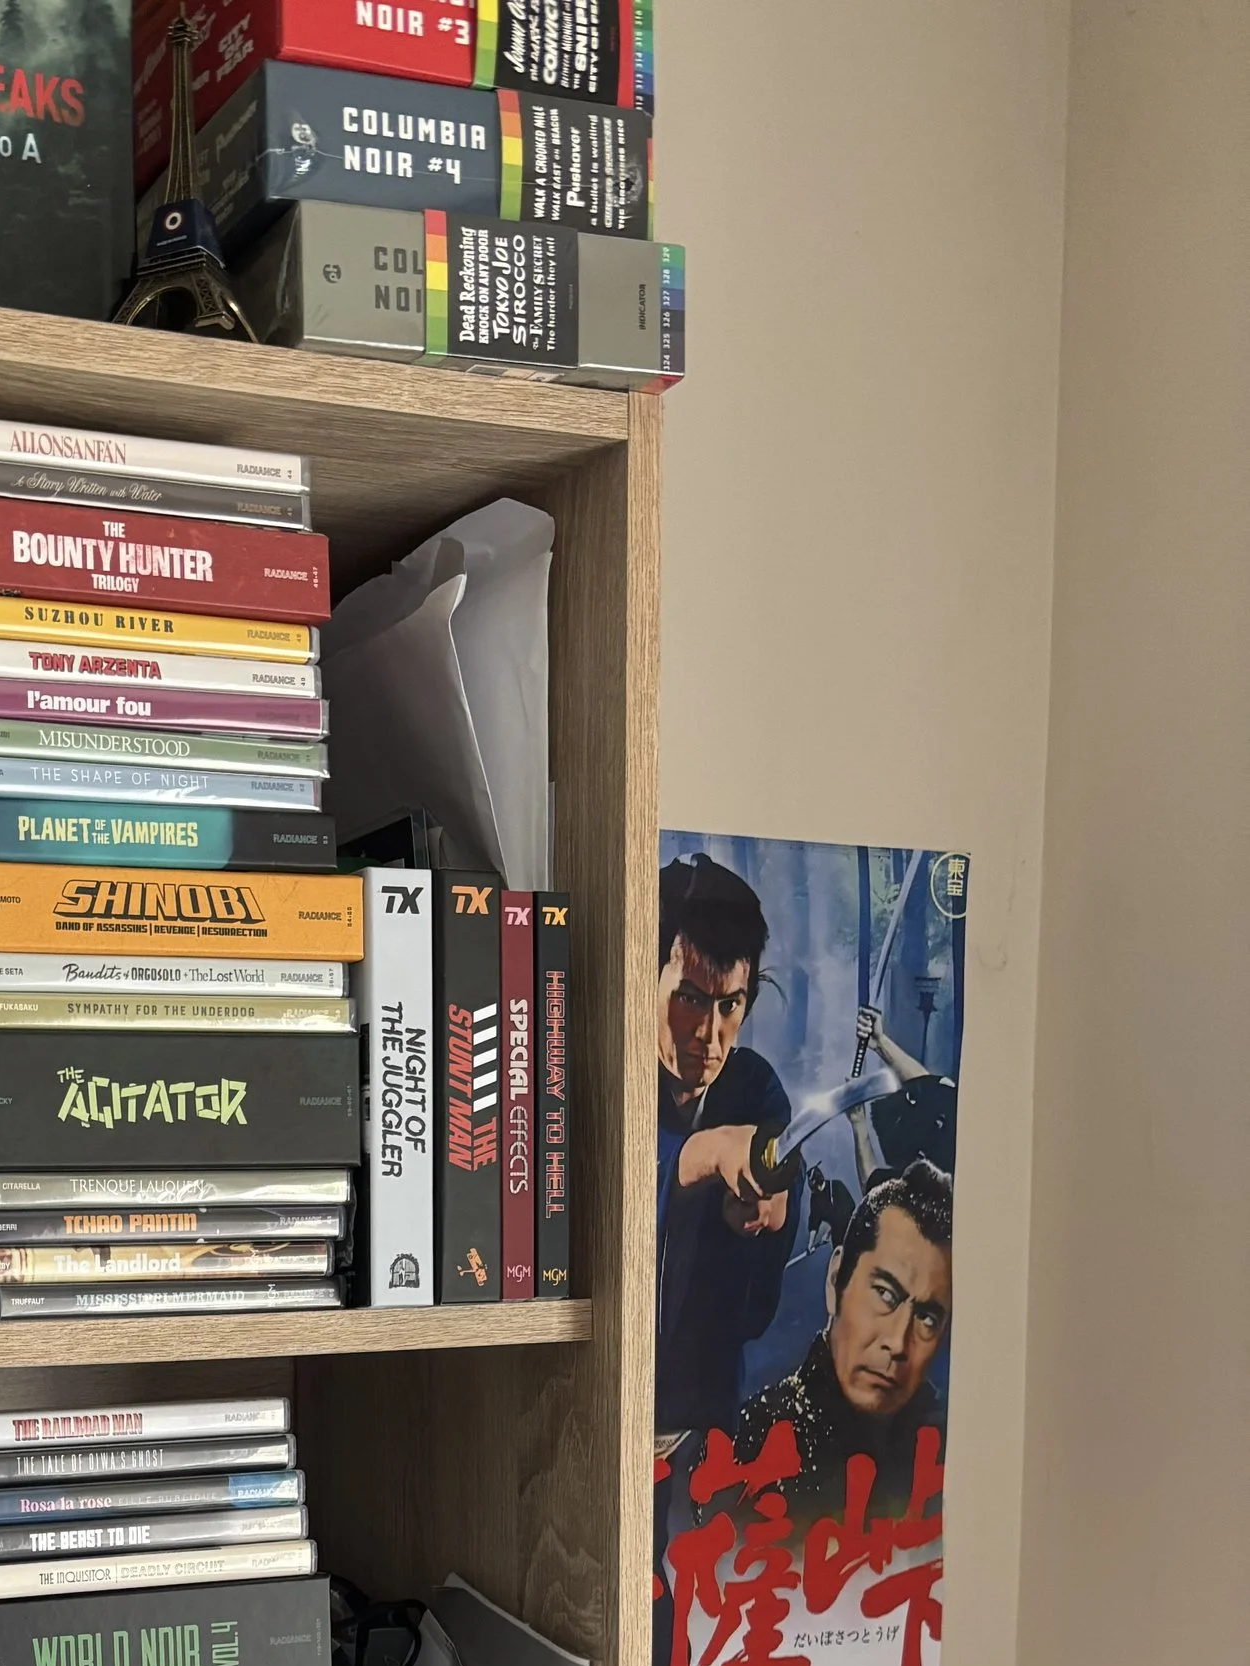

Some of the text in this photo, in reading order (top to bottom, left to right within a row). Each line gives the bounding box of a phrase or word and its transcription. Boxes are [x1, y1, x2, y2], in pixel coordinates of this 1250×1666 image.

[22, 133, 42, 163] A
[343, 107, 487, 151] COLUMBIA
[344, 145, 461, 184] NOIR #4
[460, 227, 478, 344] Dead Reckoning
[513, 235, 526, 347] SIROCCO
[639, 284, 647, 331] INDICATOR
[103, 521, 125, 537] THE
[13, 531, 213, 581] BOUNTY HUNTER
[264, 568, 308, 581] RADIANCE
[92, 573, 139, 592] TRILOGY
[53, 879, 265, 923] SHINOBI
[508, 999, 528, 1100] SPECIAL
[57, 1066, 85, 1084] THE
[381, 1002, 403, 1178] THE JUGGLER
[406, 1028, 427, 1153] NIGHT OF
[57, 1077, 248, 1128] AGITATOR
[20, 1495, 111, 1513] Rosa la rose
[794, 1625, 900, 1648] だいぼさつとうげ
